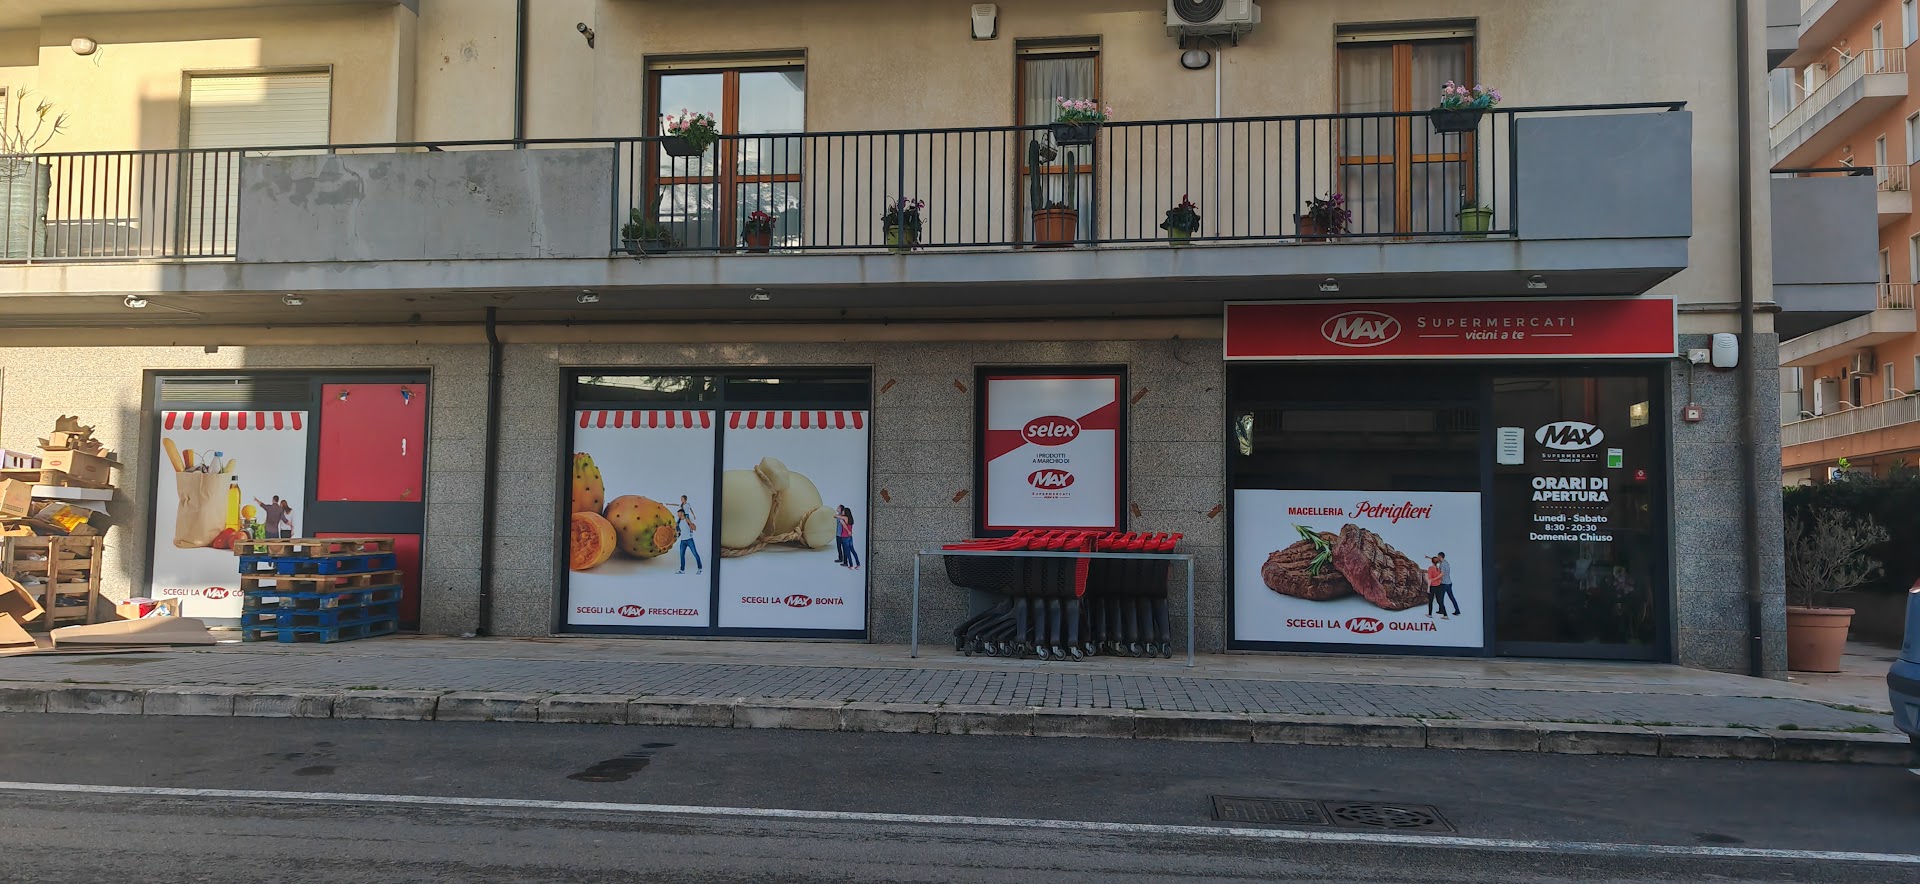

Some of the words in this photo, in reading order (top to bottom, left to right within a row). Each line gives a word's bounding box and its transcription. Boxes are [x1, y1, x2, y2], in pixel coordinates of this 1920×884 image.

[1417, 316, 1576, 328] SUPERMERCATI
[1331, 316, 1396, 341] MAX
[1465, 329, 1498, 340] vicini
[1501, 332, 1509, 340] a
[1512, 329, 1525, 340] te
[1028, 422, 1075, 437] selex
[1541, 424, 1599, 447] MAX
[1032, 471, 1071, 488] MAX
[1531, 477, 1586, 490] ORARI
[1590, 477, 1609, 490] DI
[1532, 491, 1609, 502] APERTURA
[1288, 507, 1344, 516] MACELLERIA
[1348, 500, 1433, 525] Petriglieri
[1533, 513, 1566, 523] Lunedì
[1573, 514, 1608, 523] Sabato
[1544, 524, 1566, 532] 8:30
[1571, 524, 1597, 532] 20:30
[1530, 532, 1578, 542] Domenica
[1579, 533, 1613, 542] Chiuso
[163, 588, 189, 596] SCEGLI
[190, 588, 200, 596] LA
[203, 587, 228, 599] MAX
[741, 596, 769, 604] SCEGLI
[785, 594, 811, 607] MAX
[815, 595, 844, 605] BONTÀ
[576, 606, 603, 614] SCEGLI
[605, 606, 615, 614] LA
[618, 605, 644, 617] MAX
[648, 607, 699, 616] FRESCHEZZA
[1286, 618, 1323, 629] SCEGLI
[1327, 619, 1341, 629] LA
[1347, 618, 1384, 632] MAX
[1389, 620, 1437, 632] QUALITÀ
